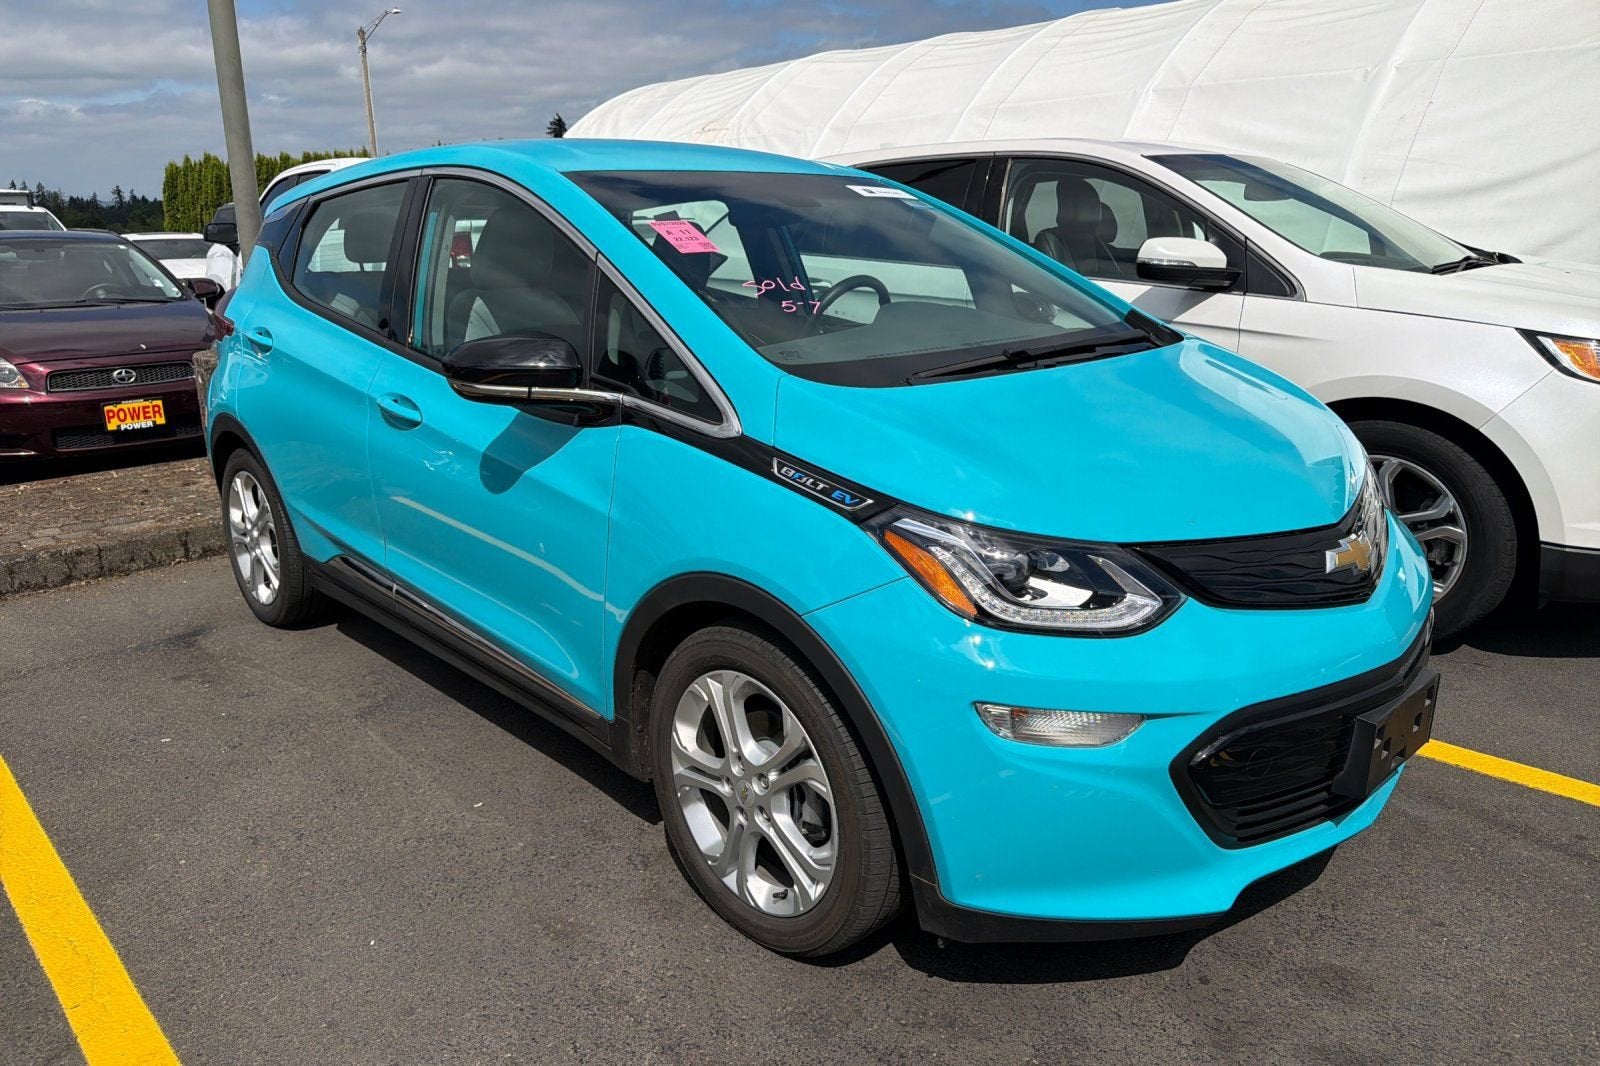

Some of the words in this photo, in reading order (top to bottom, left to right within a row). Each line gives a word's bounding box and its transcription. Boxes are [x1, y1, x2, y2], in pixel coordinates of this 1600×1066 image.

[105, 404, 163, 424] POWER
[120, 421, 153, 431] POWER
[780, 466, 830, 490] BOLT
[831, 490, 860, 504] EV
